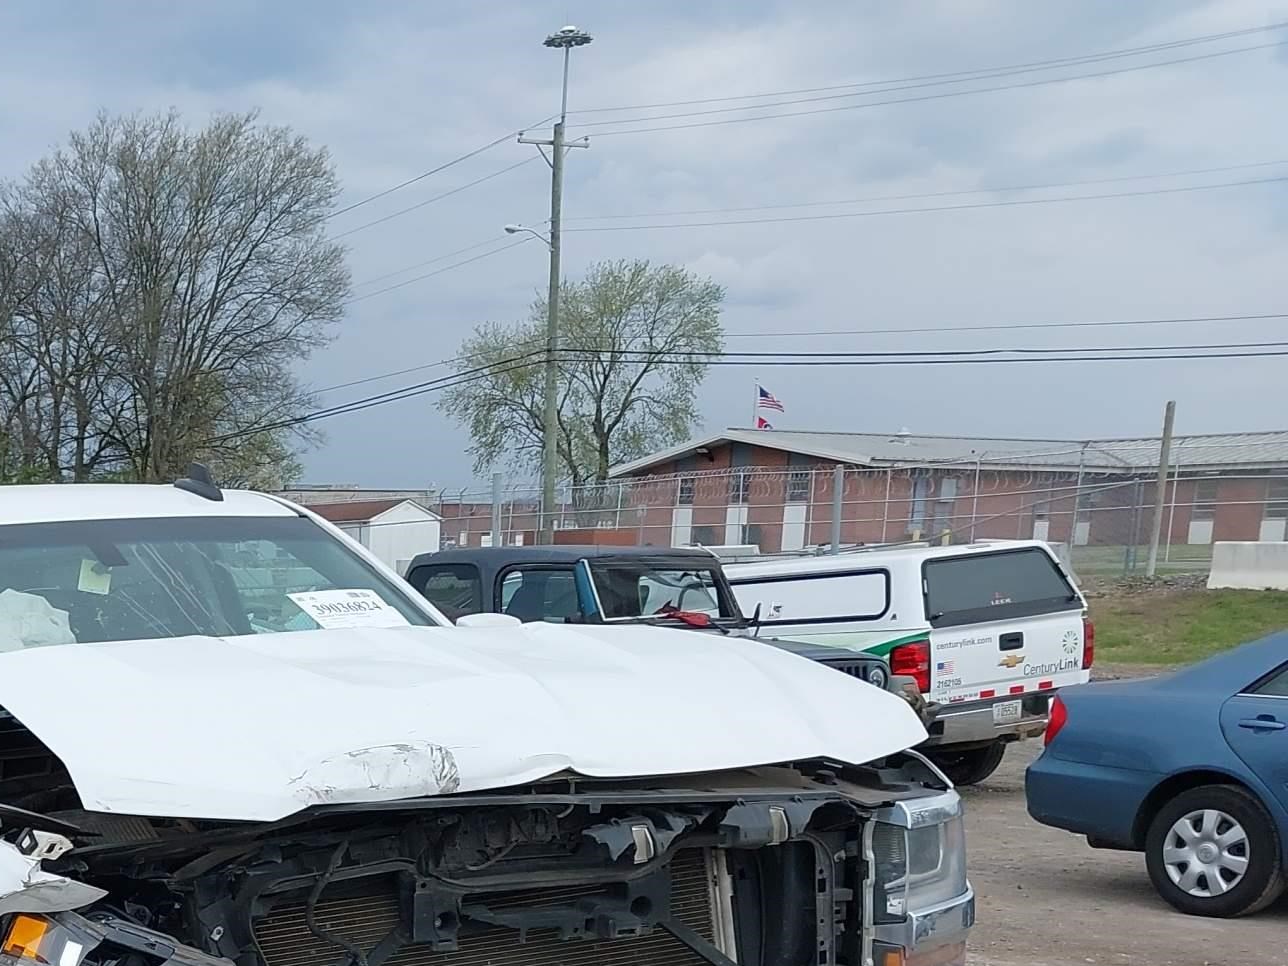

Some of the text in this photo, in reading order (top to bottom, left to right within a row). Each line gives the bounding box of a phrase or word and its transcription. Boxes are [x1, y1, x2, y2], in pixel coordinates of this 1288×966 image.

[312, 601, 383, 615] 39036824
[936, 636, 992, 650] centurylink.com
[1023, 657, 1079, 676] CenturyLink
